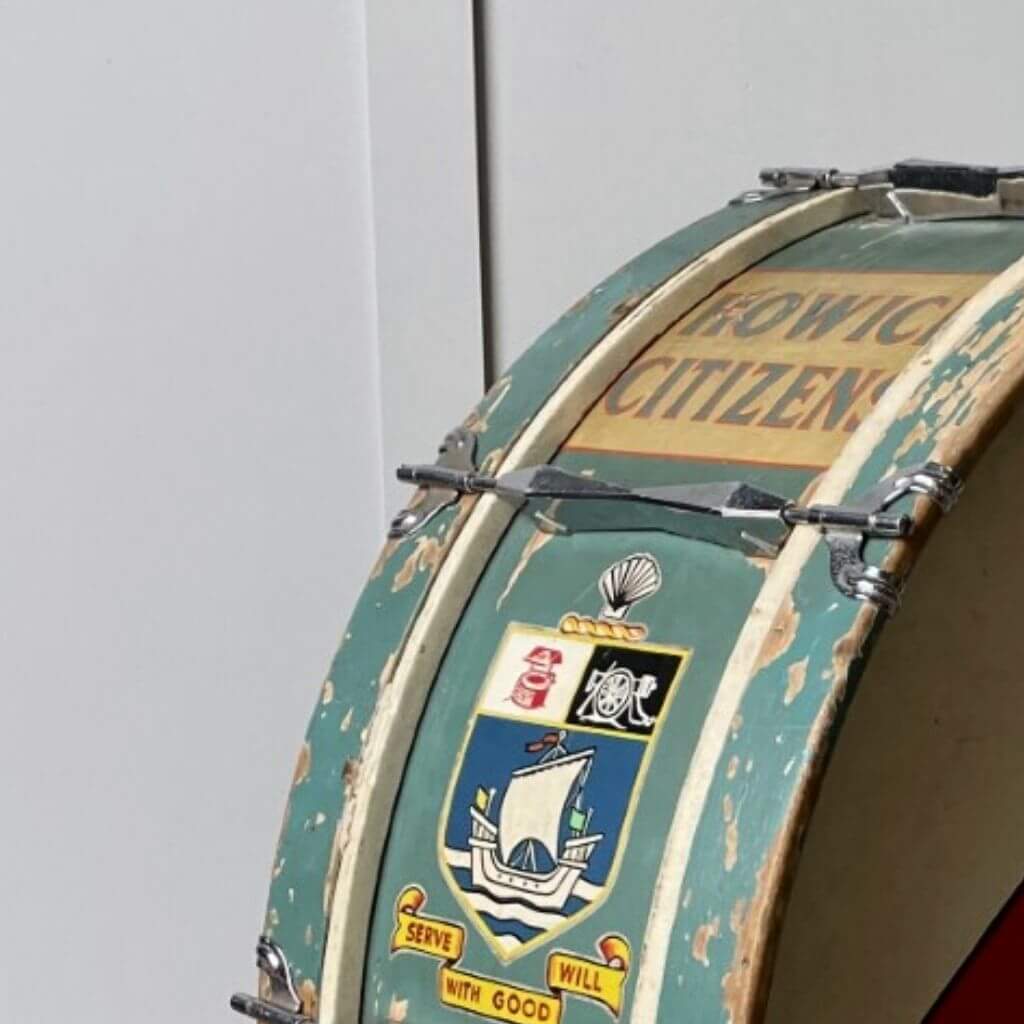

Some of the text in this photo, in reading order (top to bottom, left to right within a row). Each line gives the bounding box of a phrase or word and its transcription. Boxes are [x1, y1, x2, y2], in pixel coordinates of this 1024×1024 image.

[405, 922, 602, 1022] SERVE WITH GOOD WILL
